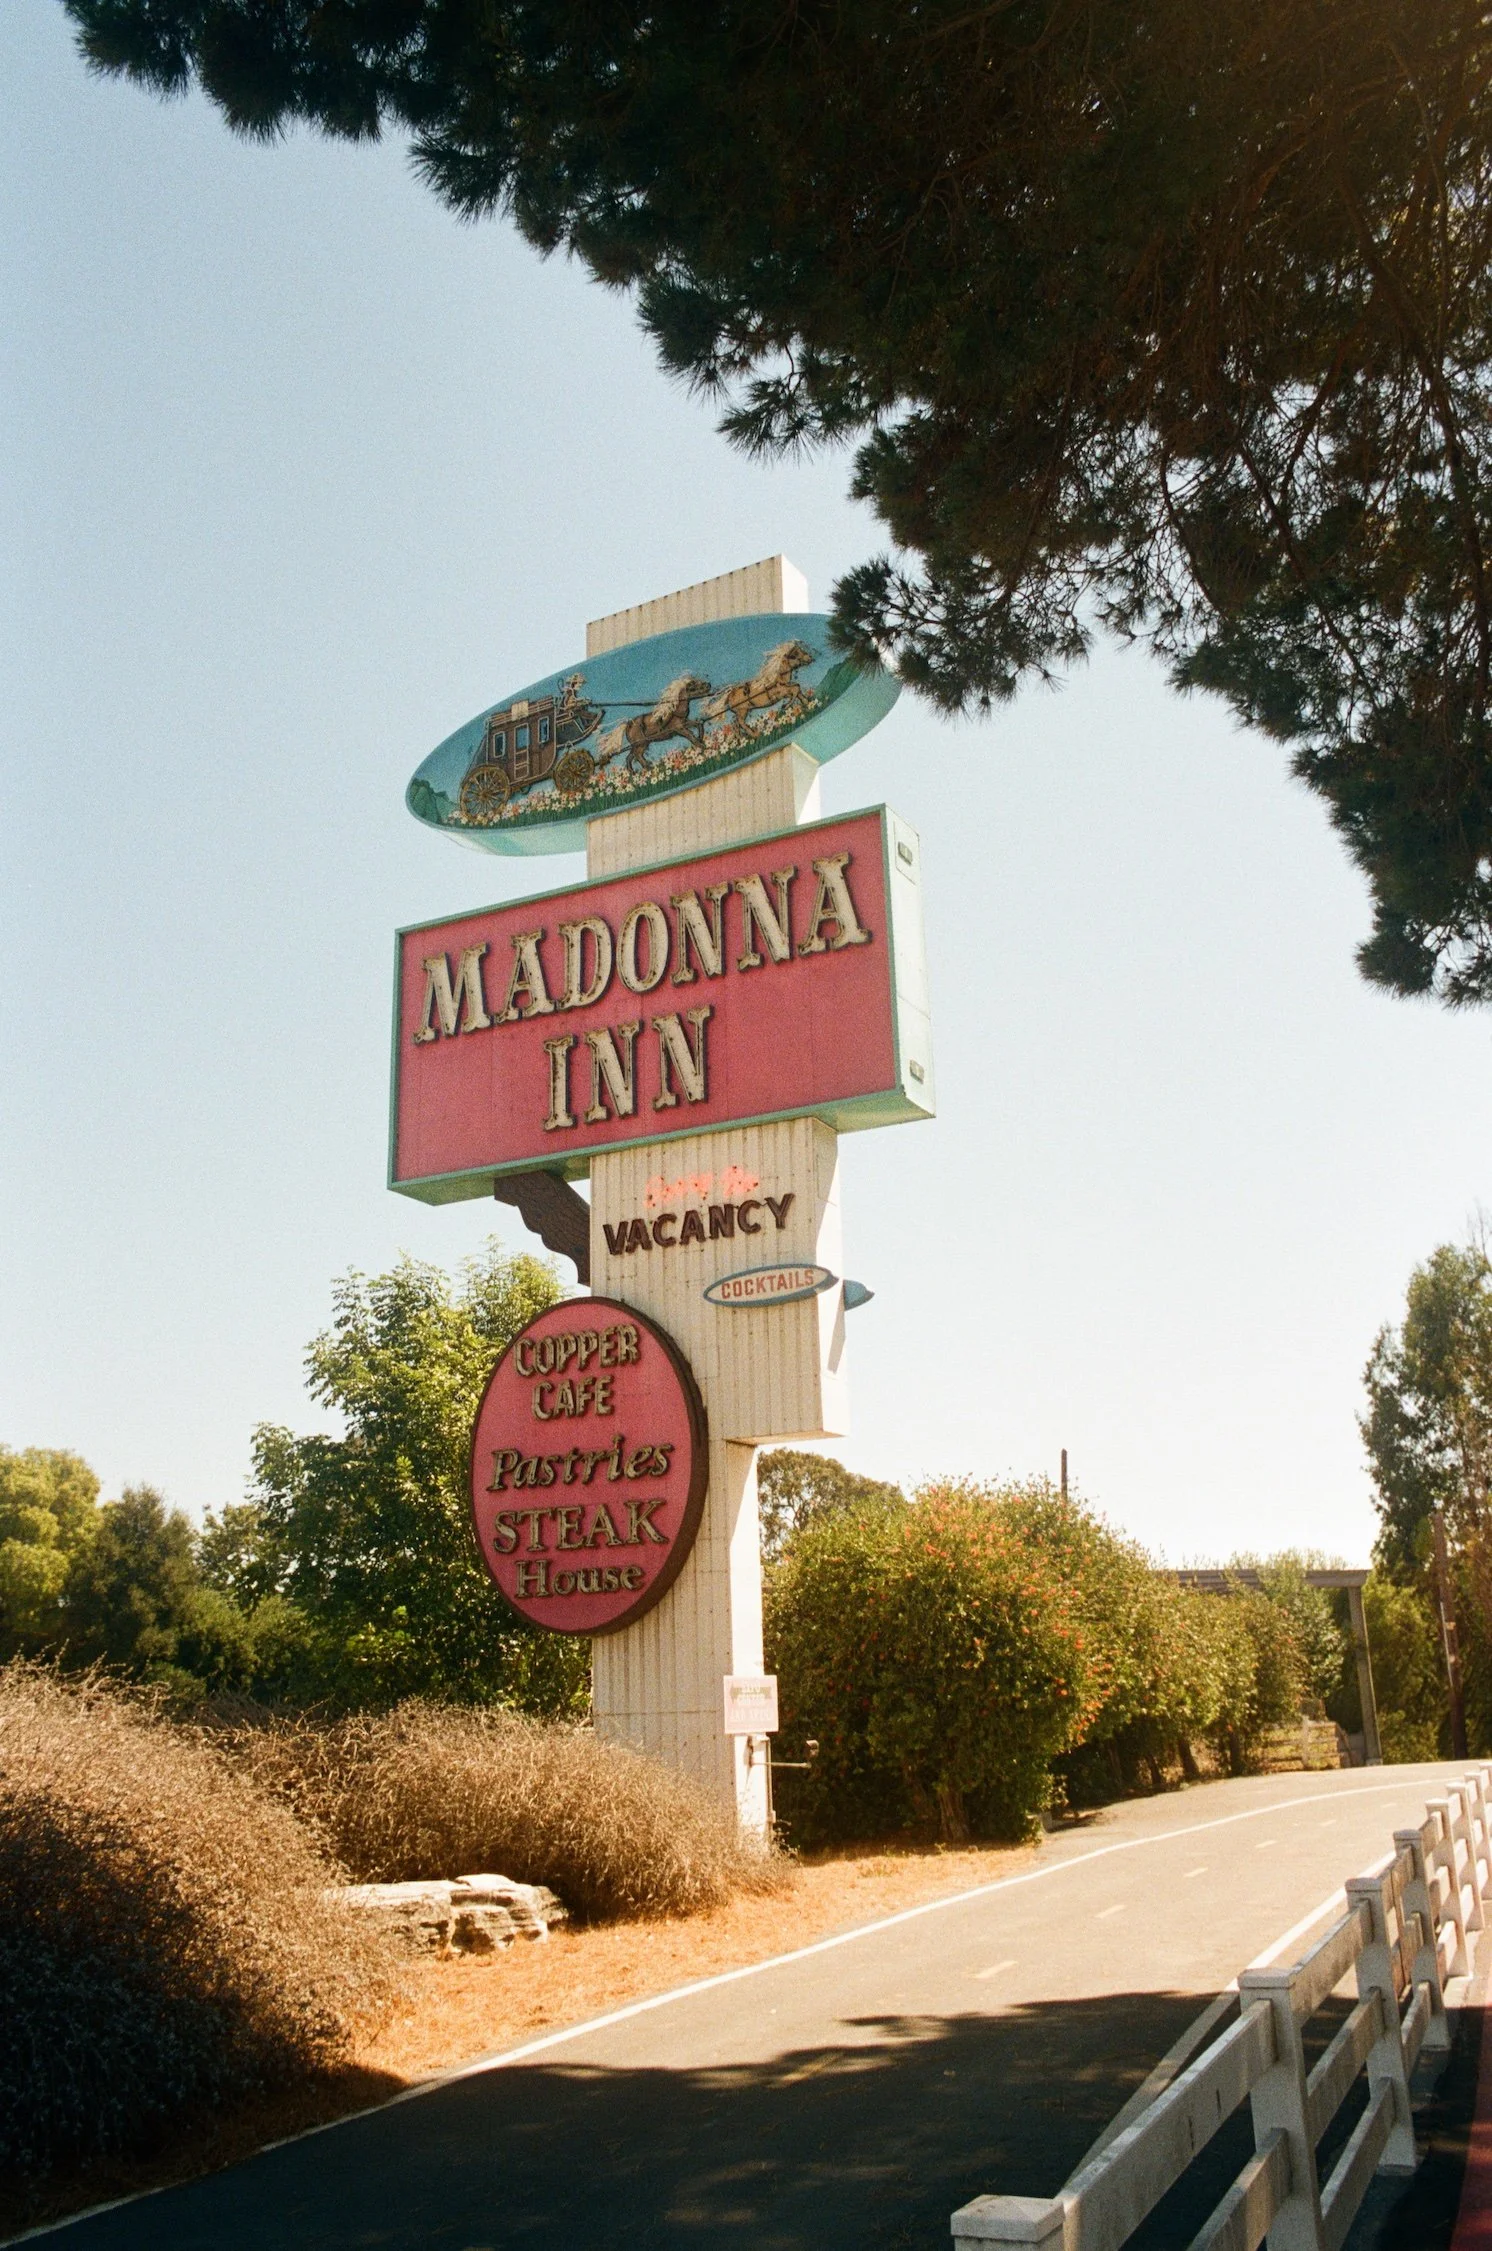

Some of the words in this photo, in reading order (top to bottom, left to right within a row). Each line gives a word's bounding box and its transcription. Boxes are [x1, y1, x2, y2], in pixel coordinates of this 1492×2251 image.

[414, 853, 870, 1042] MADONNA
[543, 1007, 711, 1130] INN
[602, 1193, 795, 1256] VACANCY
[721, 1269, 815, 1299] COCKTAILS
[515, 1325, 640, 1376] COPPER
[532, 1375, 614, 1420] CAFE
[488, 1435, 673, 1490] Pastries
[494, 1501, 668, 1553] STEAK
[516, 1560, 643, 1599] House
